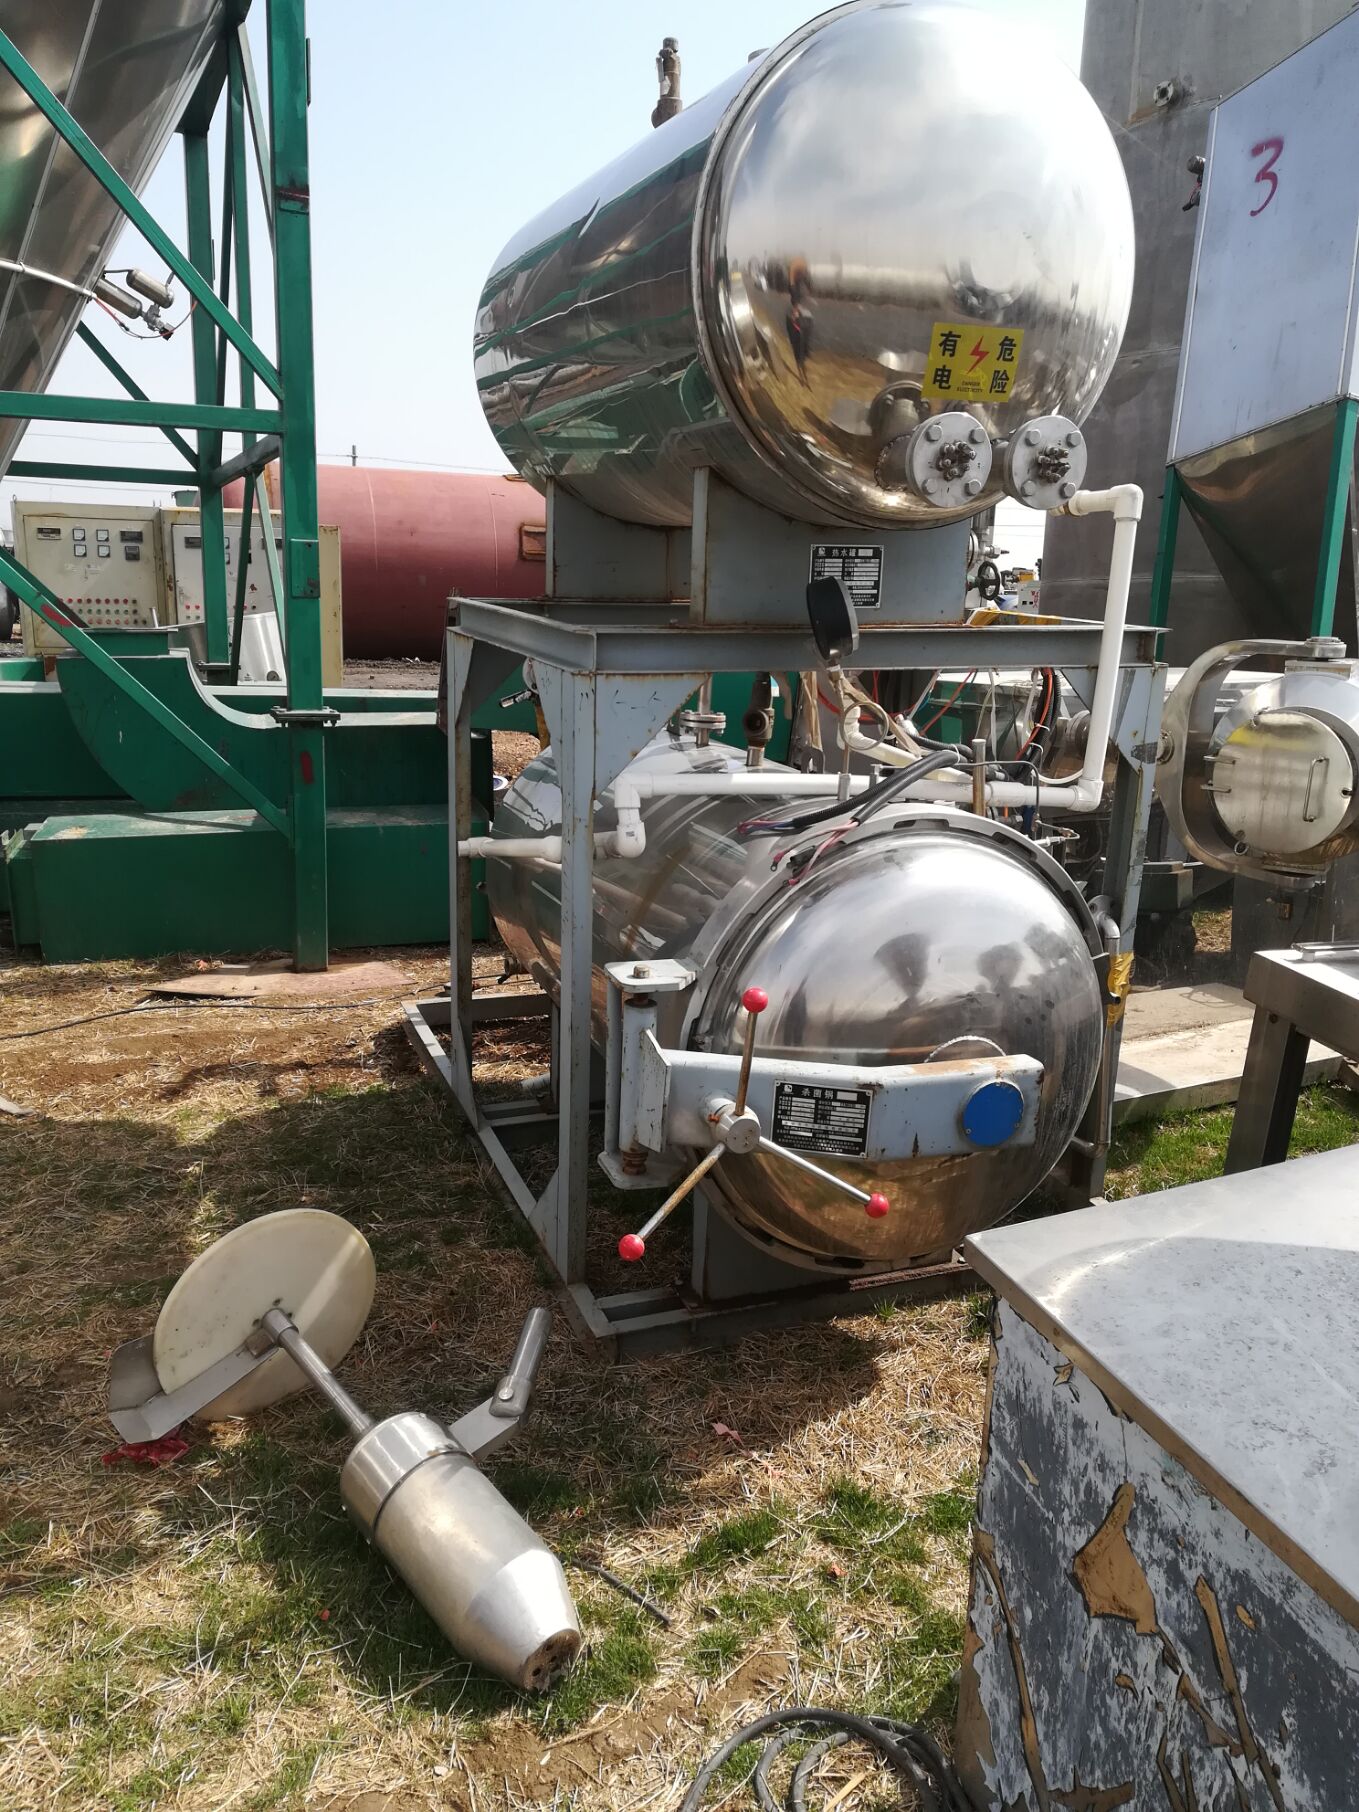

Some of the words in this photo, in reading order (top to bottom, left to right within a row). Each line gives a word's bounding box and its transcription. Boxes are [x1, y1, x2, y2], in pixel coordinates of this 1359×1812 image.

[1250, 137, 1285, 217] 3
[932, 331, 962, 390] 有电
[988, 335, 1017, 394] 危险
